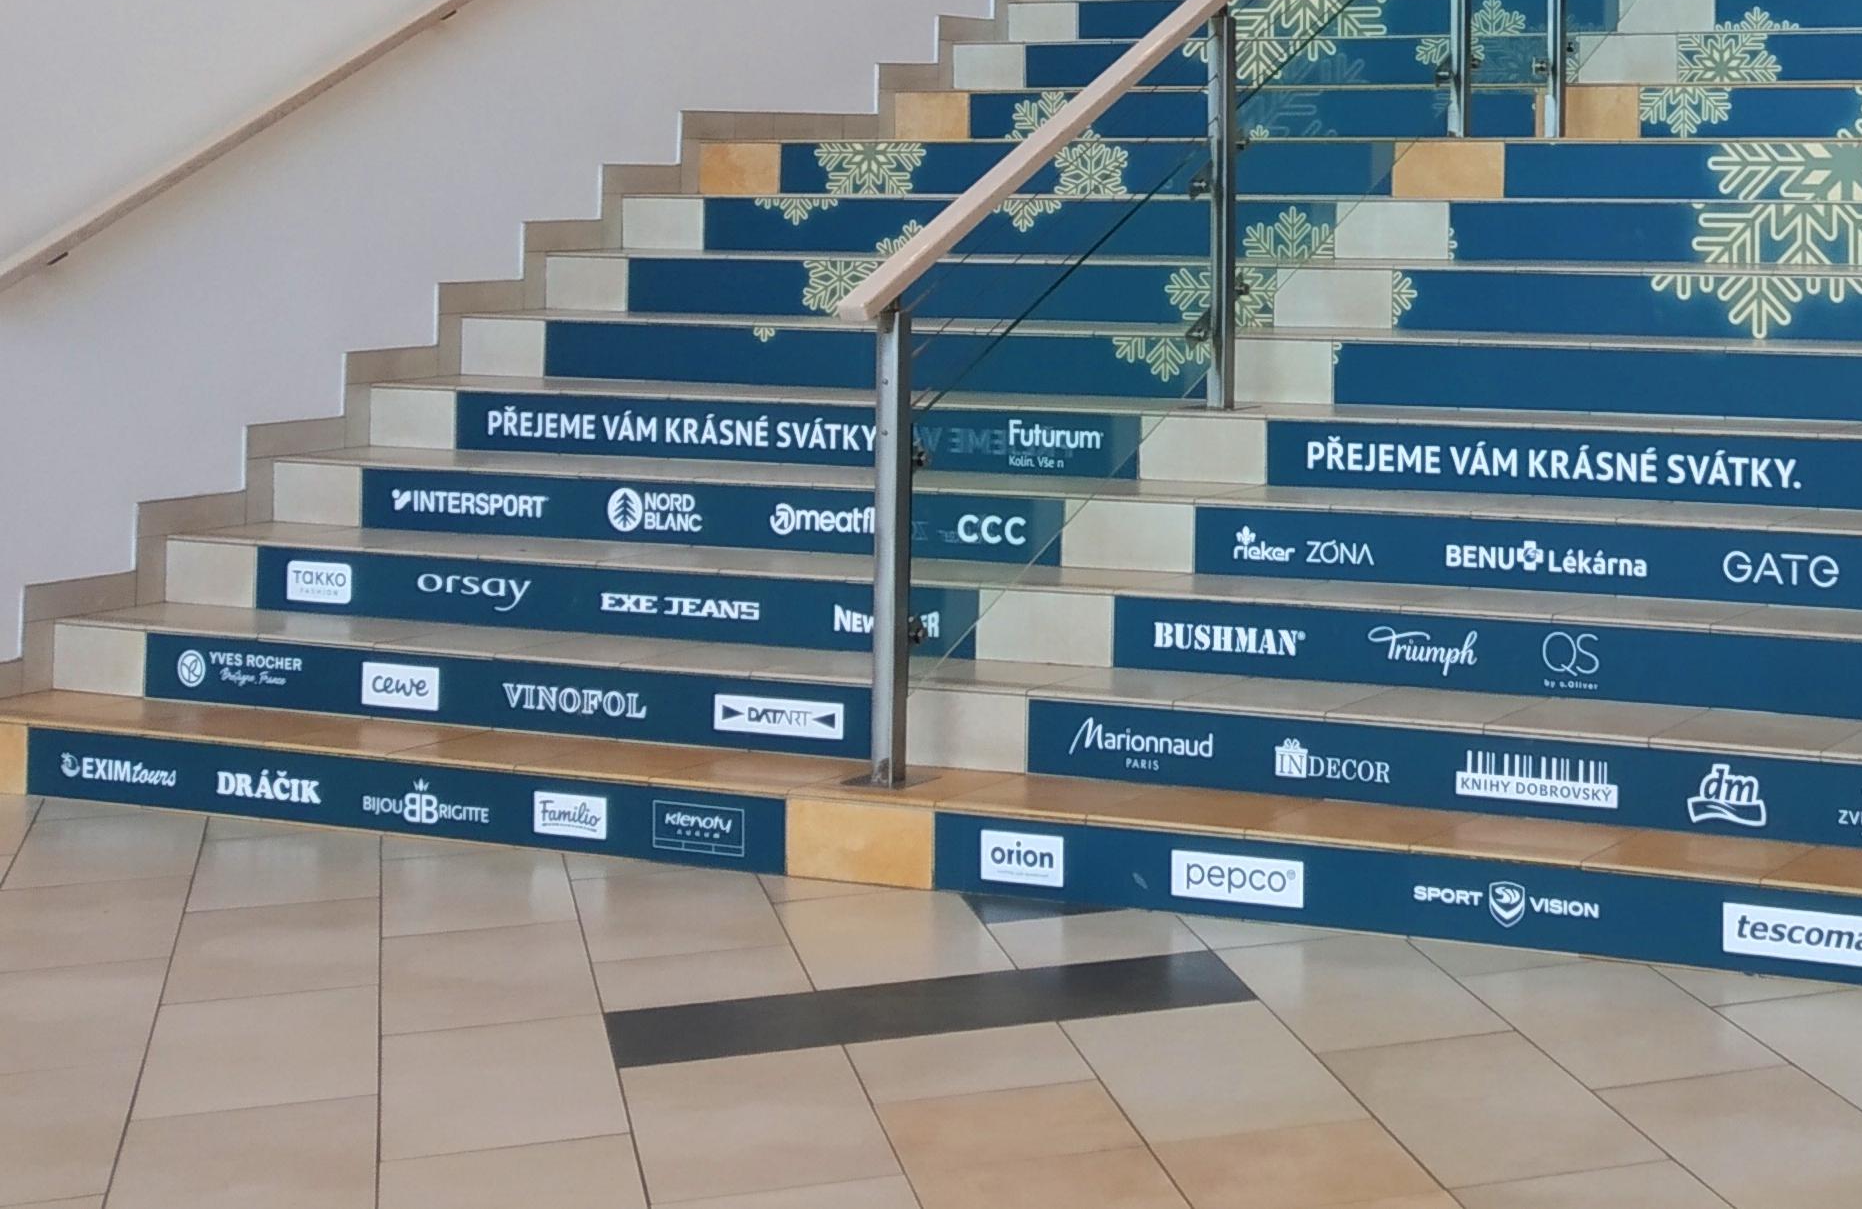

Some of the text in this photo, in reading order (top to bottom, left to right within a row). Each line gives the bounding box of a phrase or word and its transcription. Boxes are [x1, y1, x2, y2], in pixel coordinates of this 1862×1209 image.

[488, 406, 595, 439] PŘEJEME
[603, 411, 657, 442] VÁM
[666, 414, 768, 446] KRÁSNÉ
[777, 418, 876, 451] SVÁTKY
[1009, 420, 1101, 449] Futurum
[1308, 436, 1801, 488] PŘEJEME VÁM KRÁSNÉ SVÁTKY.
[414, 490, 546, 518] INTERSPORT
[644, 492, 696, 512] NORD
[644, 510, 703, 532] BLANC
[795, 506, 875, 534] meatfl
[957, 514, 1027, 546] CCC
[1233, 541, 1296, 562] rieker
[1446, 545, 1647, 577] BENU Lékárna
[418, 574, 531, 611] orsay
[601, 593, 759, 620] EXE JEANS
[209, 651, 303, 671] YVES ROCHER
[1368, 626, 1477, 676] Triumph
[1542, 631, 1599, 677] QS
[371, 675, 429, 697] cewe
[503, 683, 646, 718] VINOFOL
[747, 706, 813, 729] DATART
[1069, 717, 1214, 759] Marionnaud
[1126, 758, 1159, 770] PARIS
[217, 770, 321, 804] DRÁČIK
[1460, 777, 1613, 803] KNIHY DOBROVSKÝ
[1705, 767, 1756, 803] dm
[363, 795, 402, 816] BIJOU
[540, 799, 601, 826] Familio
[990, 841, 1054, 869] orion
[1413, 885, 1600, 919] SPORT VISION
